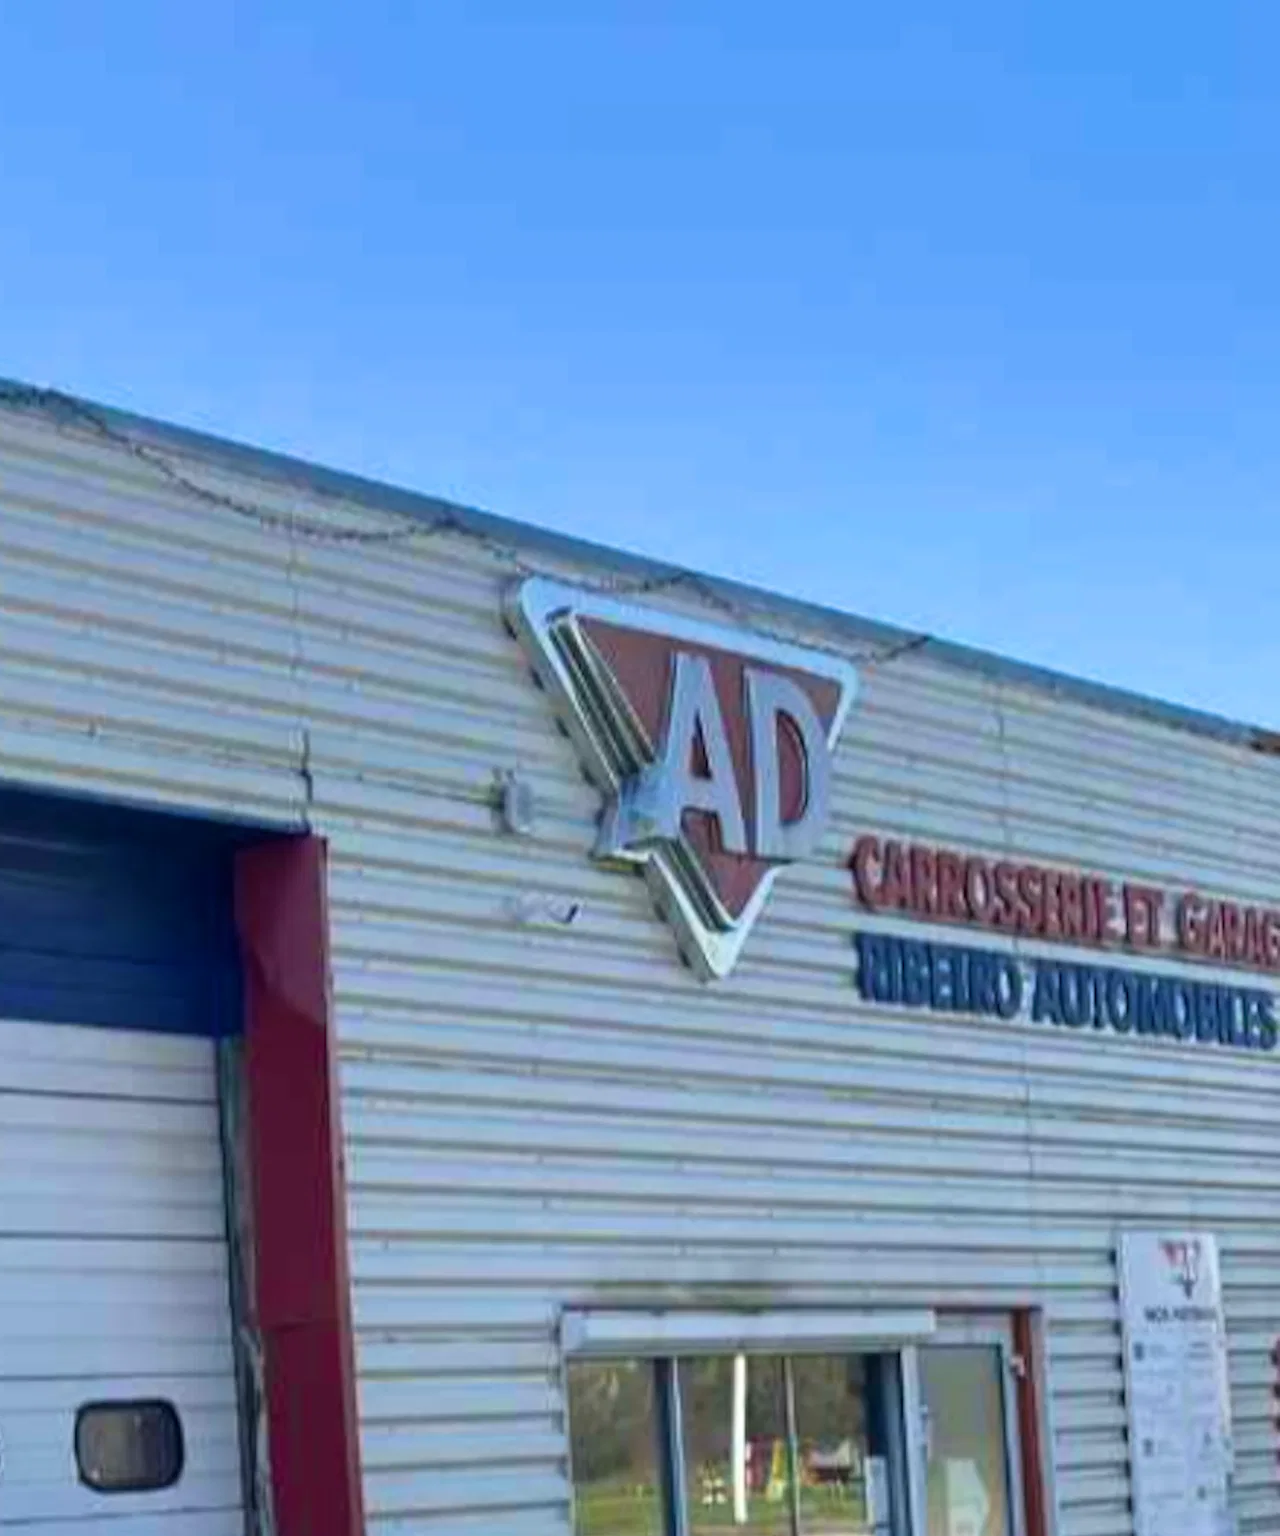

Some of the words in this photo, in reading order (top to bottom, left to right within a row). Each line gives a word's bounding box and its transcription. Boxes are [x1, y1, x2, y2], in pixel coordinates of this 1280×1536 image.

[612, 650, 833, 860] AD
[848, 833, 1119, 944] CARROSSERIE
[1122, 880, 1169, 950] ET
[853, 930, 1025, 1021] RIBEIRO
[1030, 957, 1279, 1051] AUTOMOBILES
